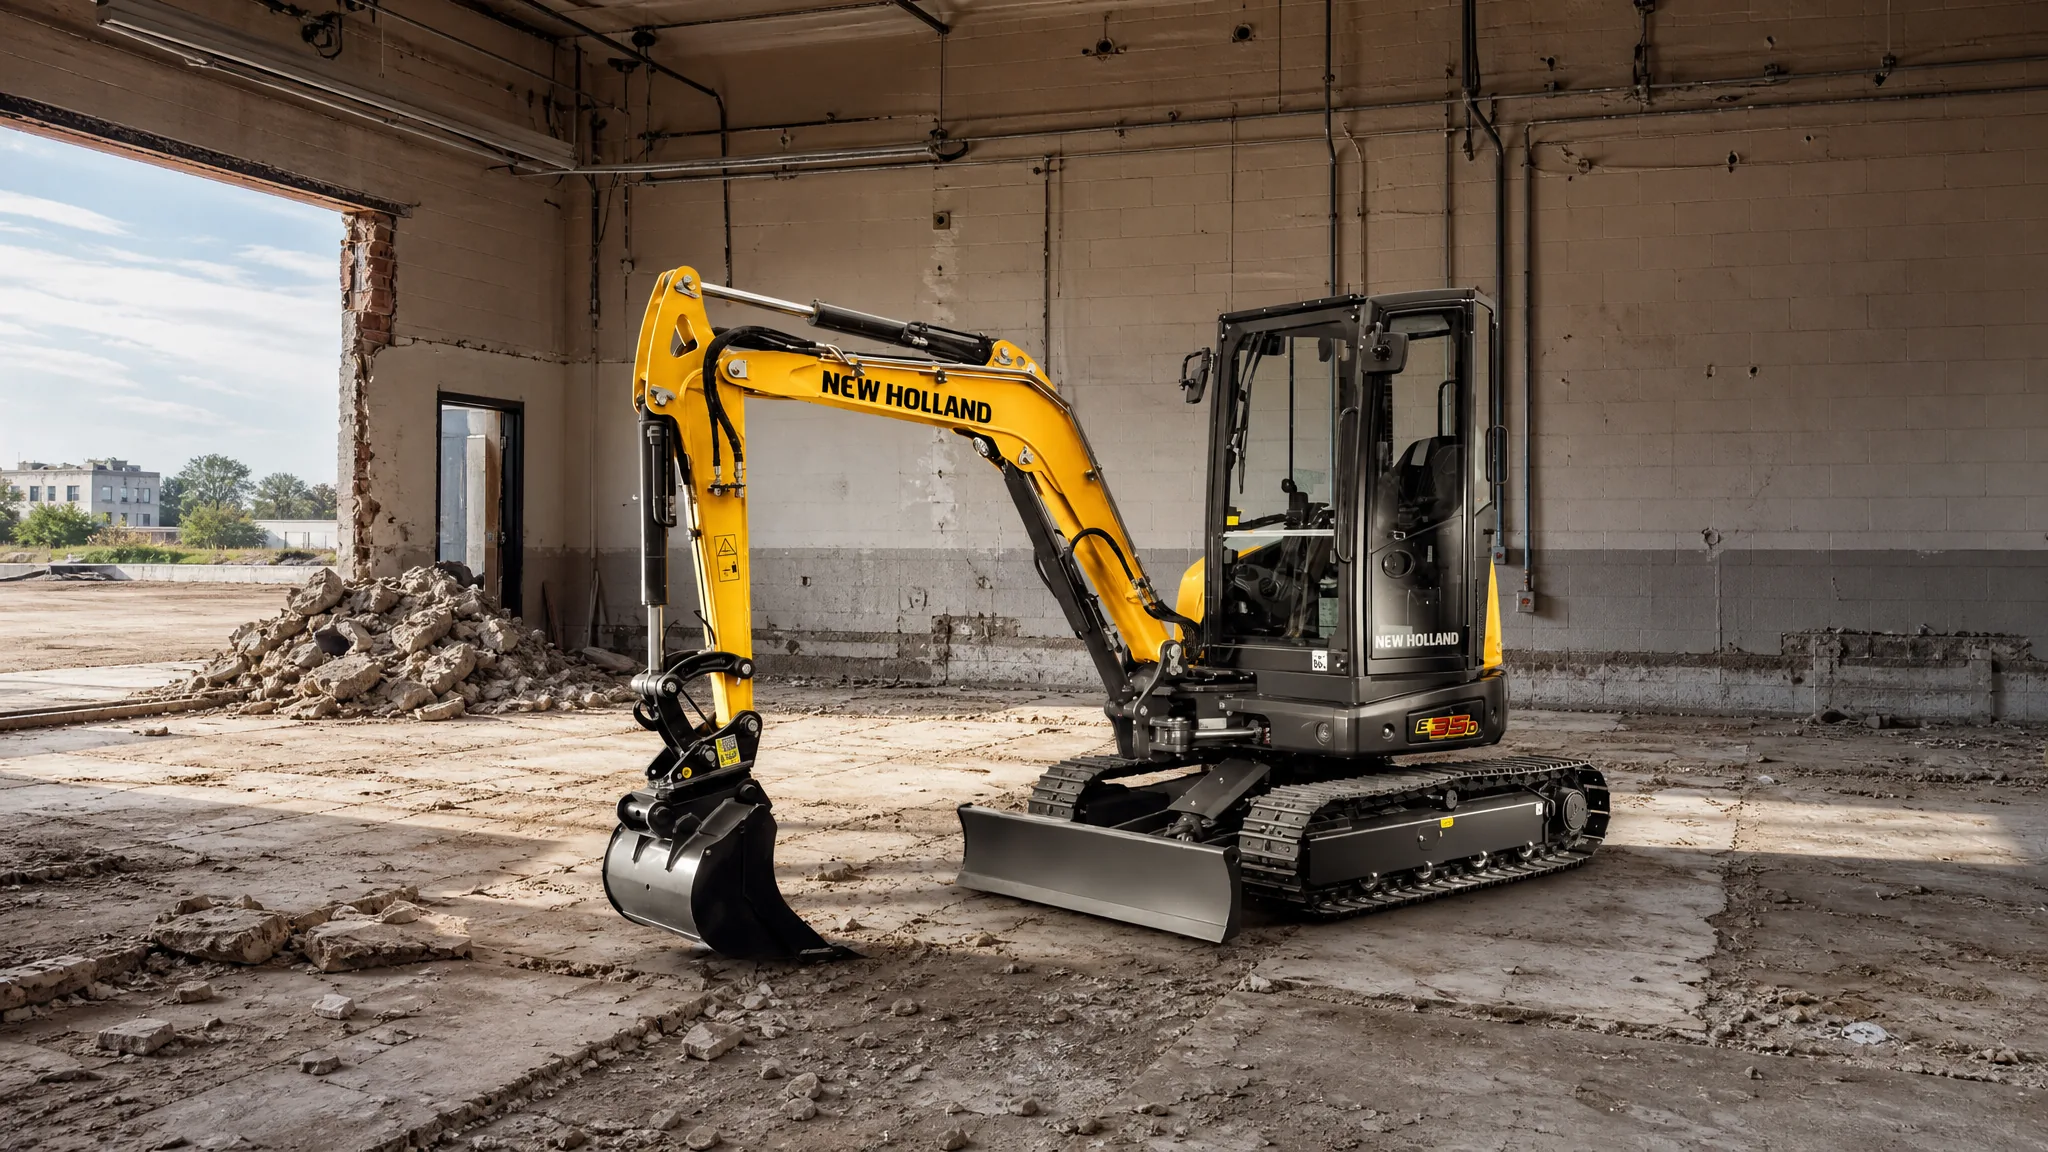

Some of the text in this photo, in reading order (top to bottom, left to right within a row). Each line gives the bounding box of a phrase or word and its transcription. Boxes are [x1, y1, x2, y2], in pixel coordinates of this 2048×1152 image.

[822, 370, 992, 424] NEW HOLLAND
[1375, 632, 1459, 649] NEW HOLLAND
